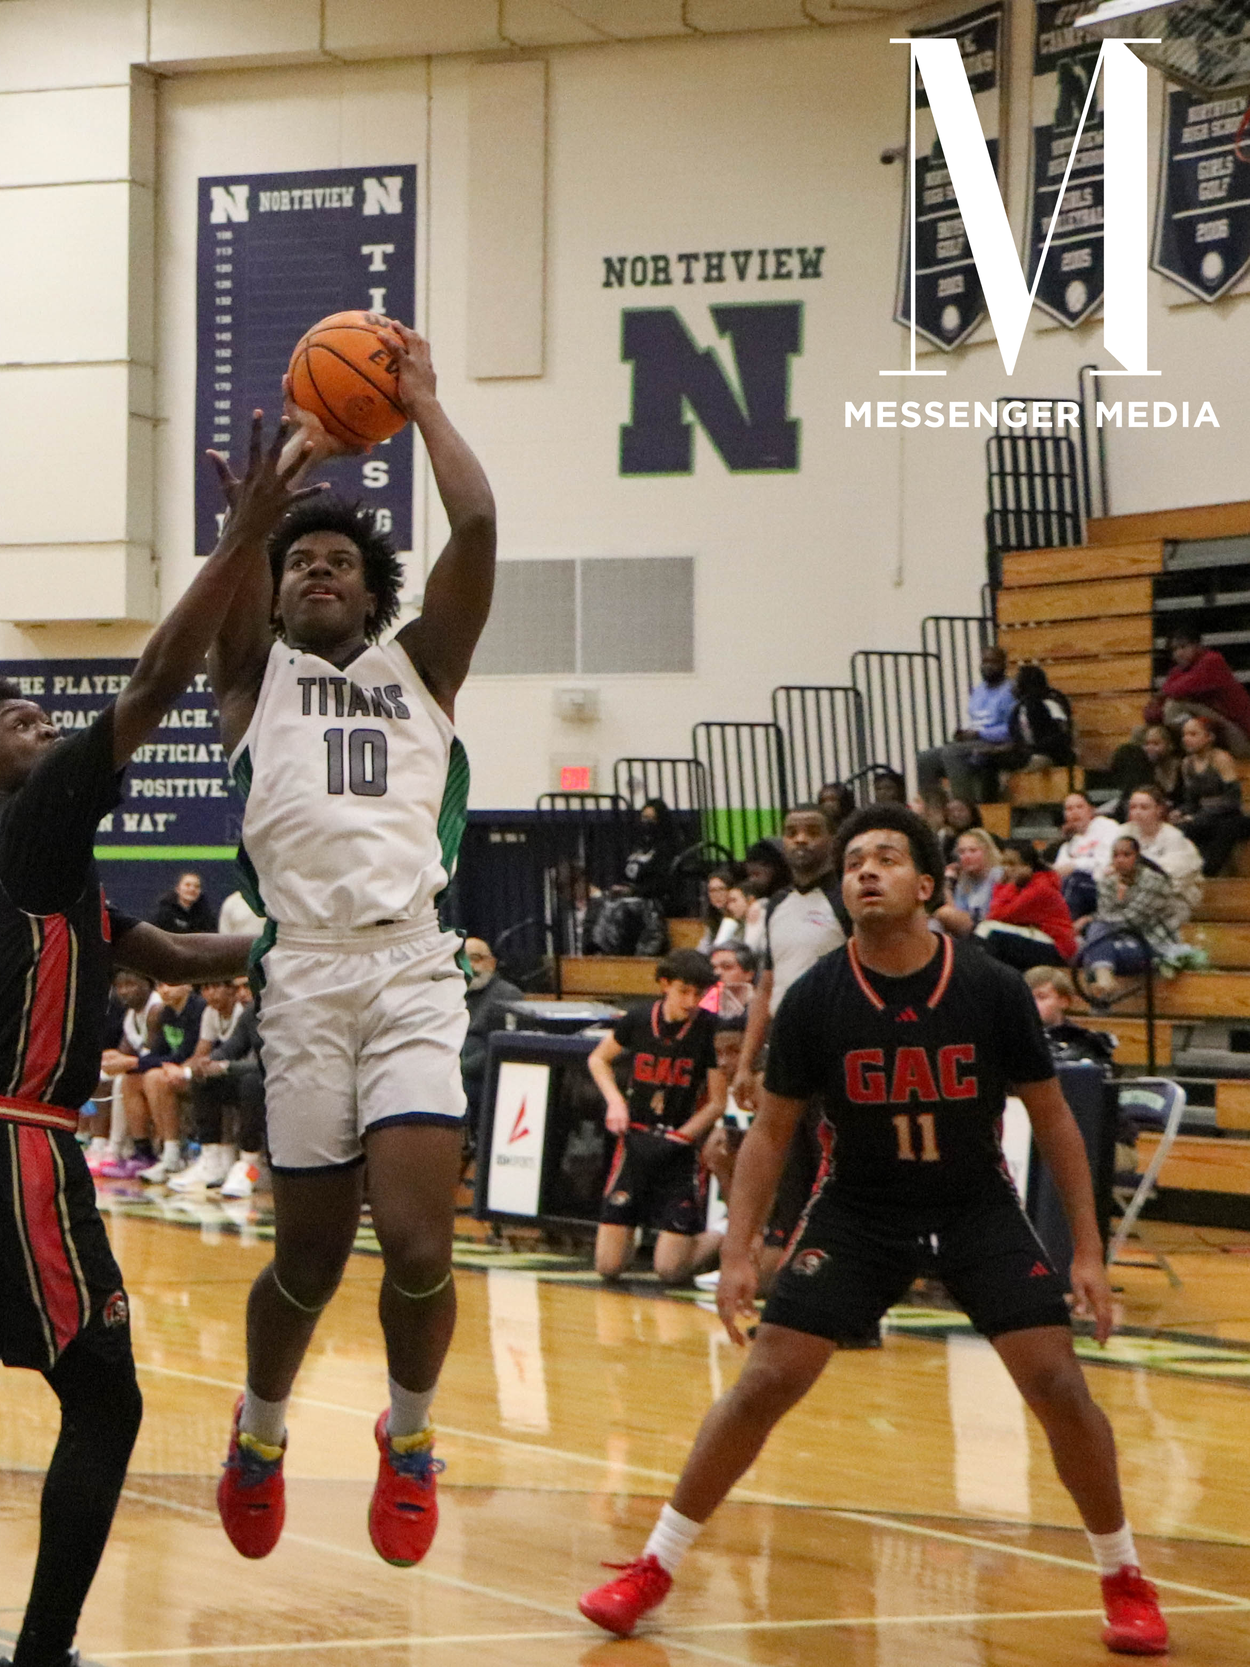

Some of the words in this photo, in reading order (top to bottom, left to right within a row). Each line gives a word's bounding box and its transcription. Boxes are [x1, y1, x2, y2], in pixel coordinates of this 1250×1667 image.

[210, 184, 250, 224] N
[258, 186, 355, 212] NORTHVIEW
[362, 176, 403, 216] N
[602, 245, 826, 288] NORTHVIEW
[619, 300, 804, 478] N
[297, 677, 411, 719] TITANS
[131, 743, 228, 763] OFFICIAT
[324, 728, 387, 797] 10
[634, 1053, 694, 1087] GAC
[844, 1044, 978, 1104] GAC
[892, 1113, 941, 1162] 11
